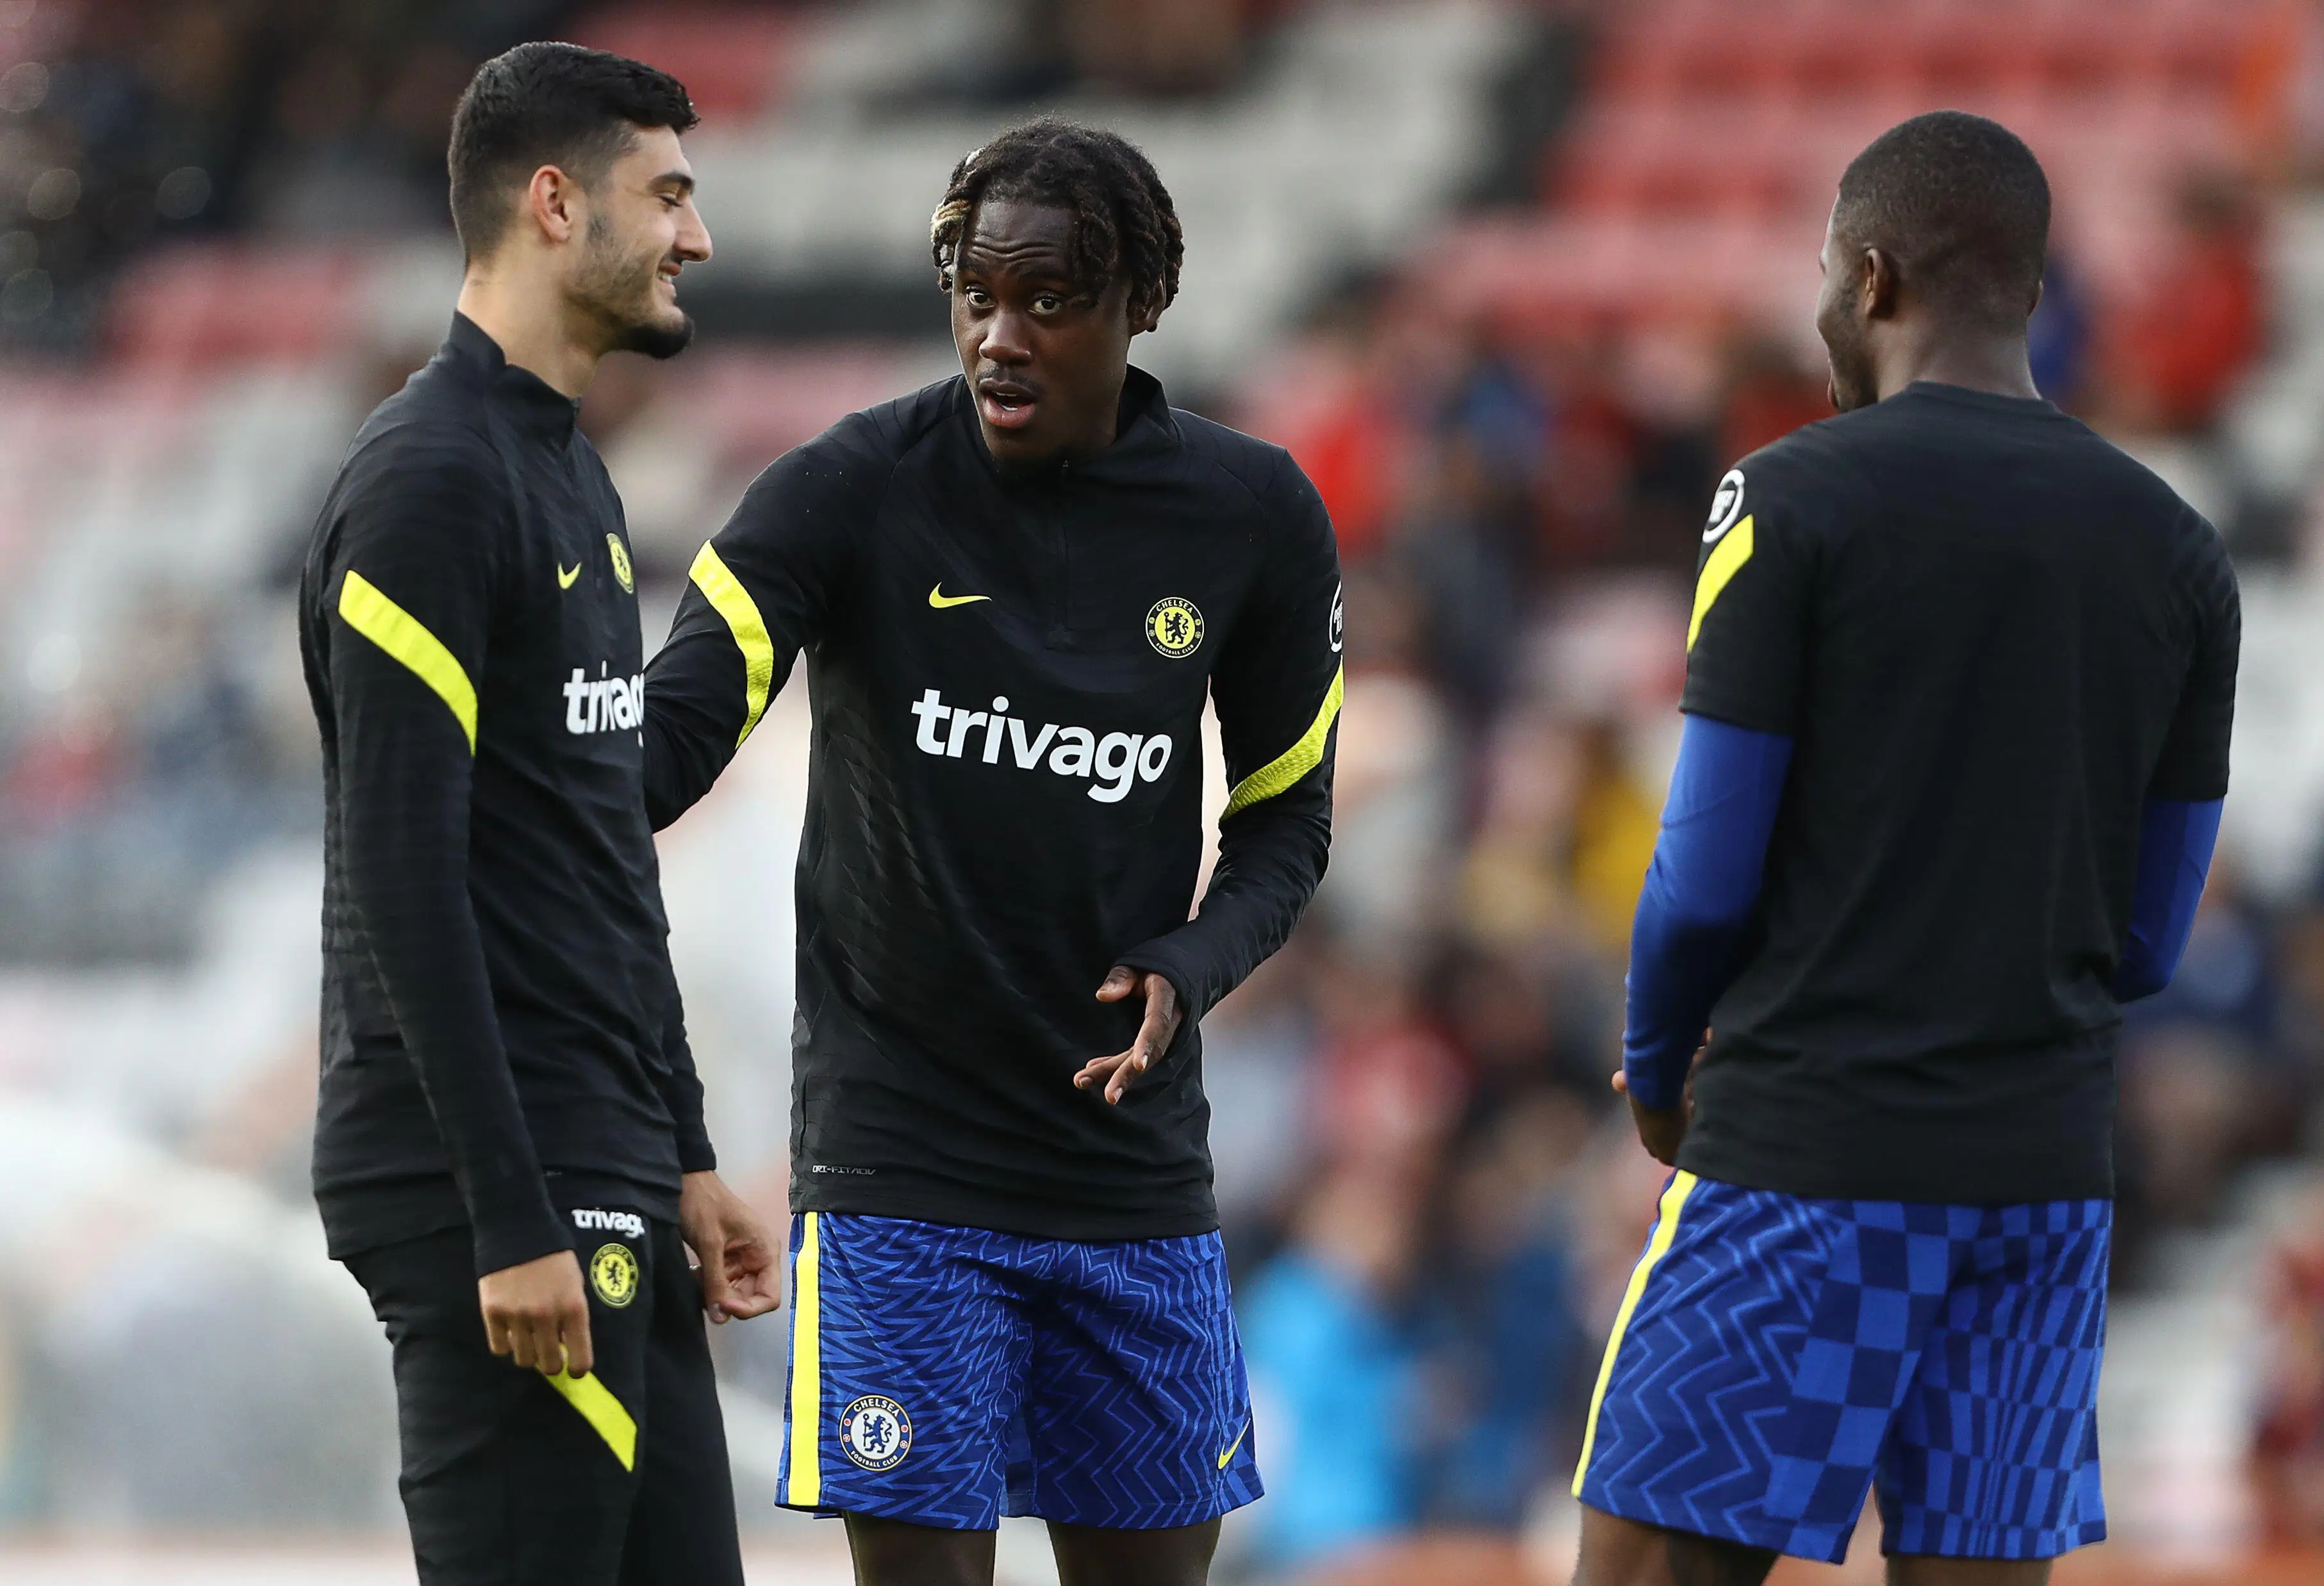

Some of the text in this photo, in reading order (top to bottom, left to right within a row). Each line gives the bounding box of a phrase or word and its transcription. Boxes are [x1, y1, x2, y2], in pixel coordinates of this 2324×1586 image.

[1156, 600, 1193, 614] CHELSEA
[911, 689, 1173, 803] trivago
[853, 1398, 900, 1418] CHELSEA
[850, 1450, 898, 1467] FOOTBALL CLUB
